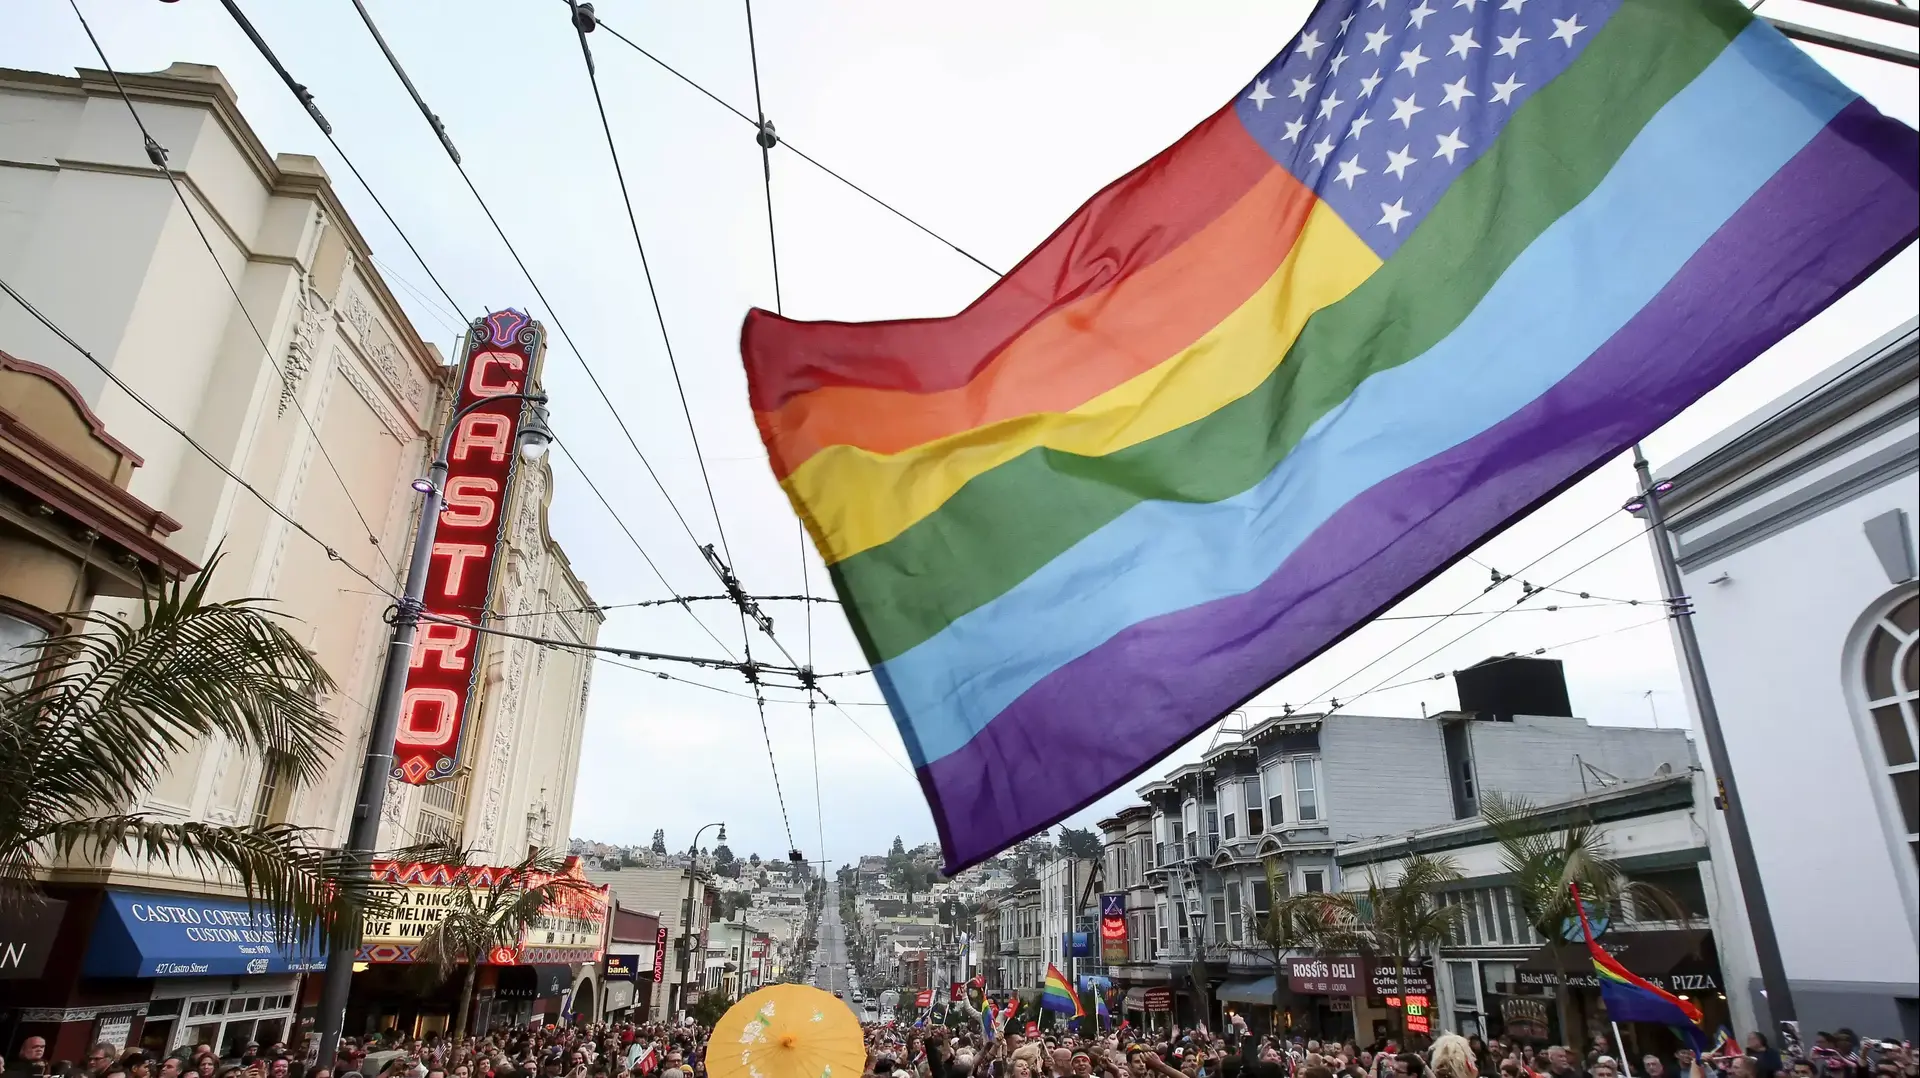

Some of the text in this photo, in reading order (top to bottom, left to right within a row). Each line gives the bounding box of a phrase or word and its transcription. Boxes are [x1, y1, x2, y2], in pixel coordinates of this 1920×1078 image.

[395, 351, 523, 746] CASTRO
[400, 892, 409, 905] A
[416, 892, 450, 907] RING
[132, 903, 201, 924] CASTRO
[203, 909, 258, 927] COFFEE
[186, 927, 243, 943] CUSTOM
[362, 921, 391, 936] OVE
[239, 945, 270, 954] Since 1970
[653, 928, 666, 982] SLIDERS
[155, 962, 208, 974] 427 Castro Street
[609, 958, 619, 966] us
[607, 966, 629, 975] bank
[1332, 963, 1356, 978] DELI
[1375, 967, 1423, 976] GOUMET
[1521, 973, 1543, 984] Baked
[1544, 973, 1561, 985] Wit
[1671, 974, 1717, 990] PIZZA
[501, 988, 533, 997] NAILS
[1377, 987, 1427, 995] Sandiches
